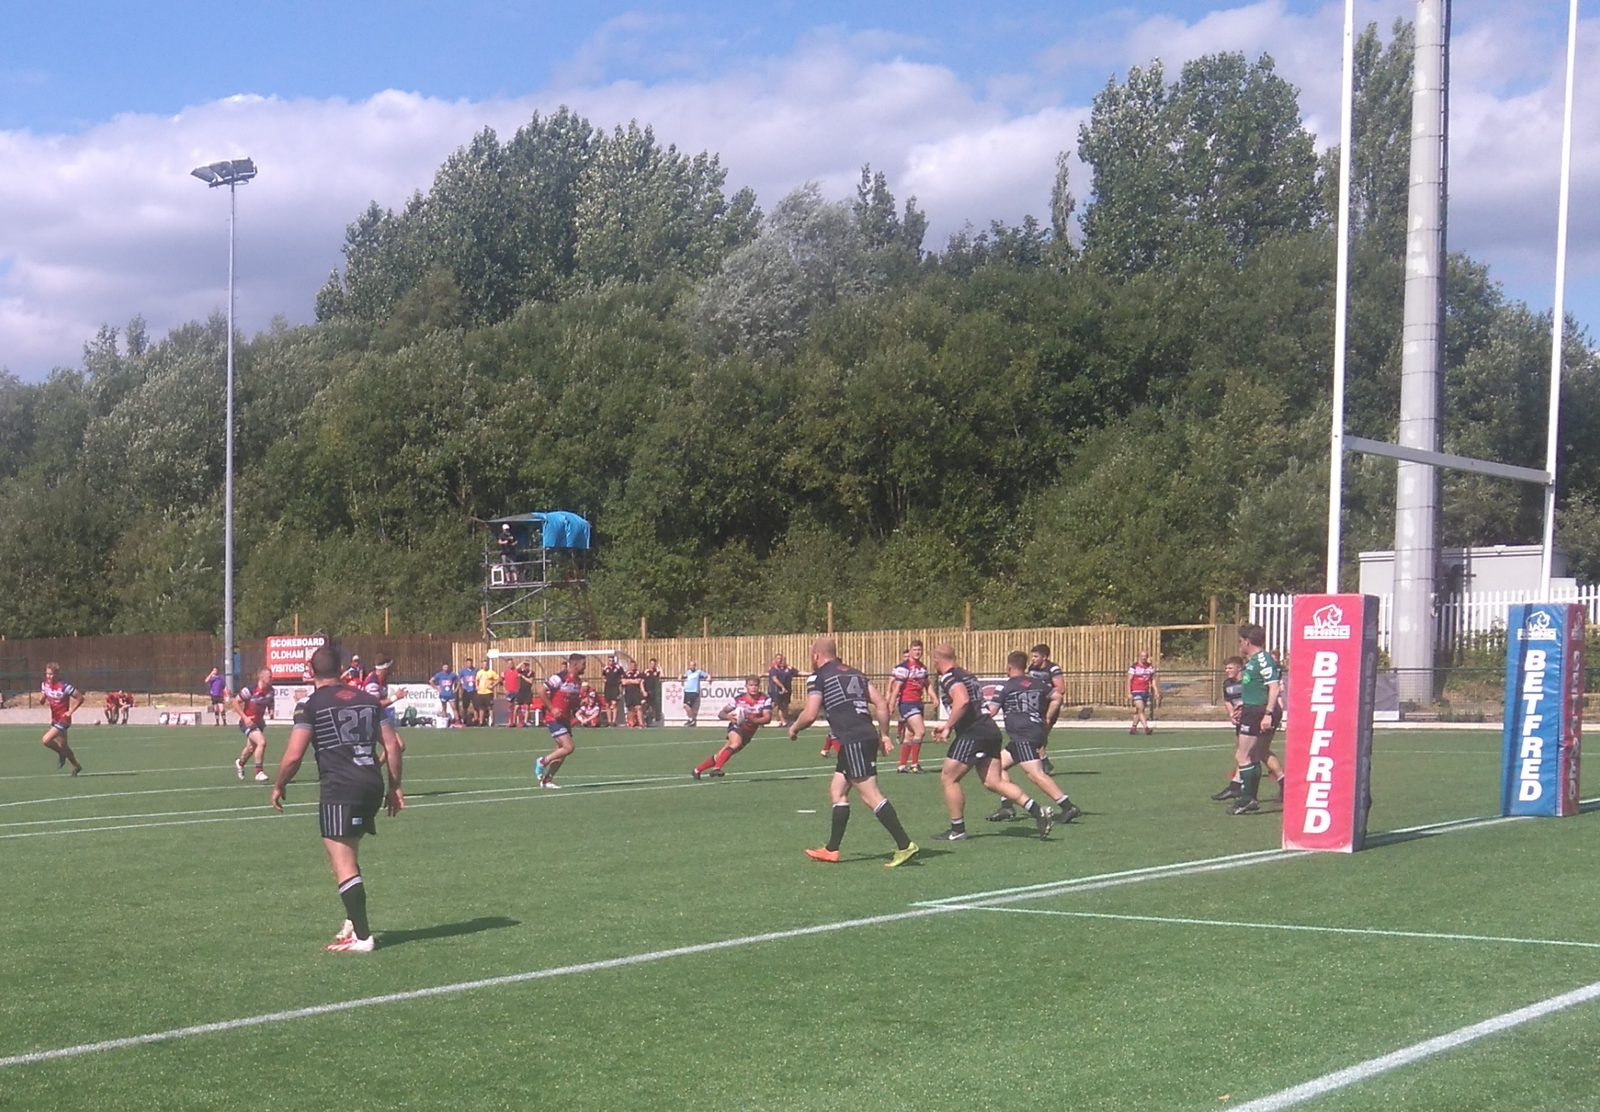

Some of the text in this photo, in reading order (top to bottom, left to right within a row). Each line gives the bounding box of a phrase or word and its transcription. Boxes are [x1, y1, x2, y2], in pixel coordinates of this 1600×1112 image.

[270, 638, 324, 647] SCOREBOARD
[271, 650, 304, 659] OLDHAM
[271, 664, 304, 672] VISITORS
[847, 676, 863, 698] 4
[338, 708, 374, 742] 21
[1519, 649, 1547, 801] BETFRED
[1303, 651, 1339, 834] BETFRED
